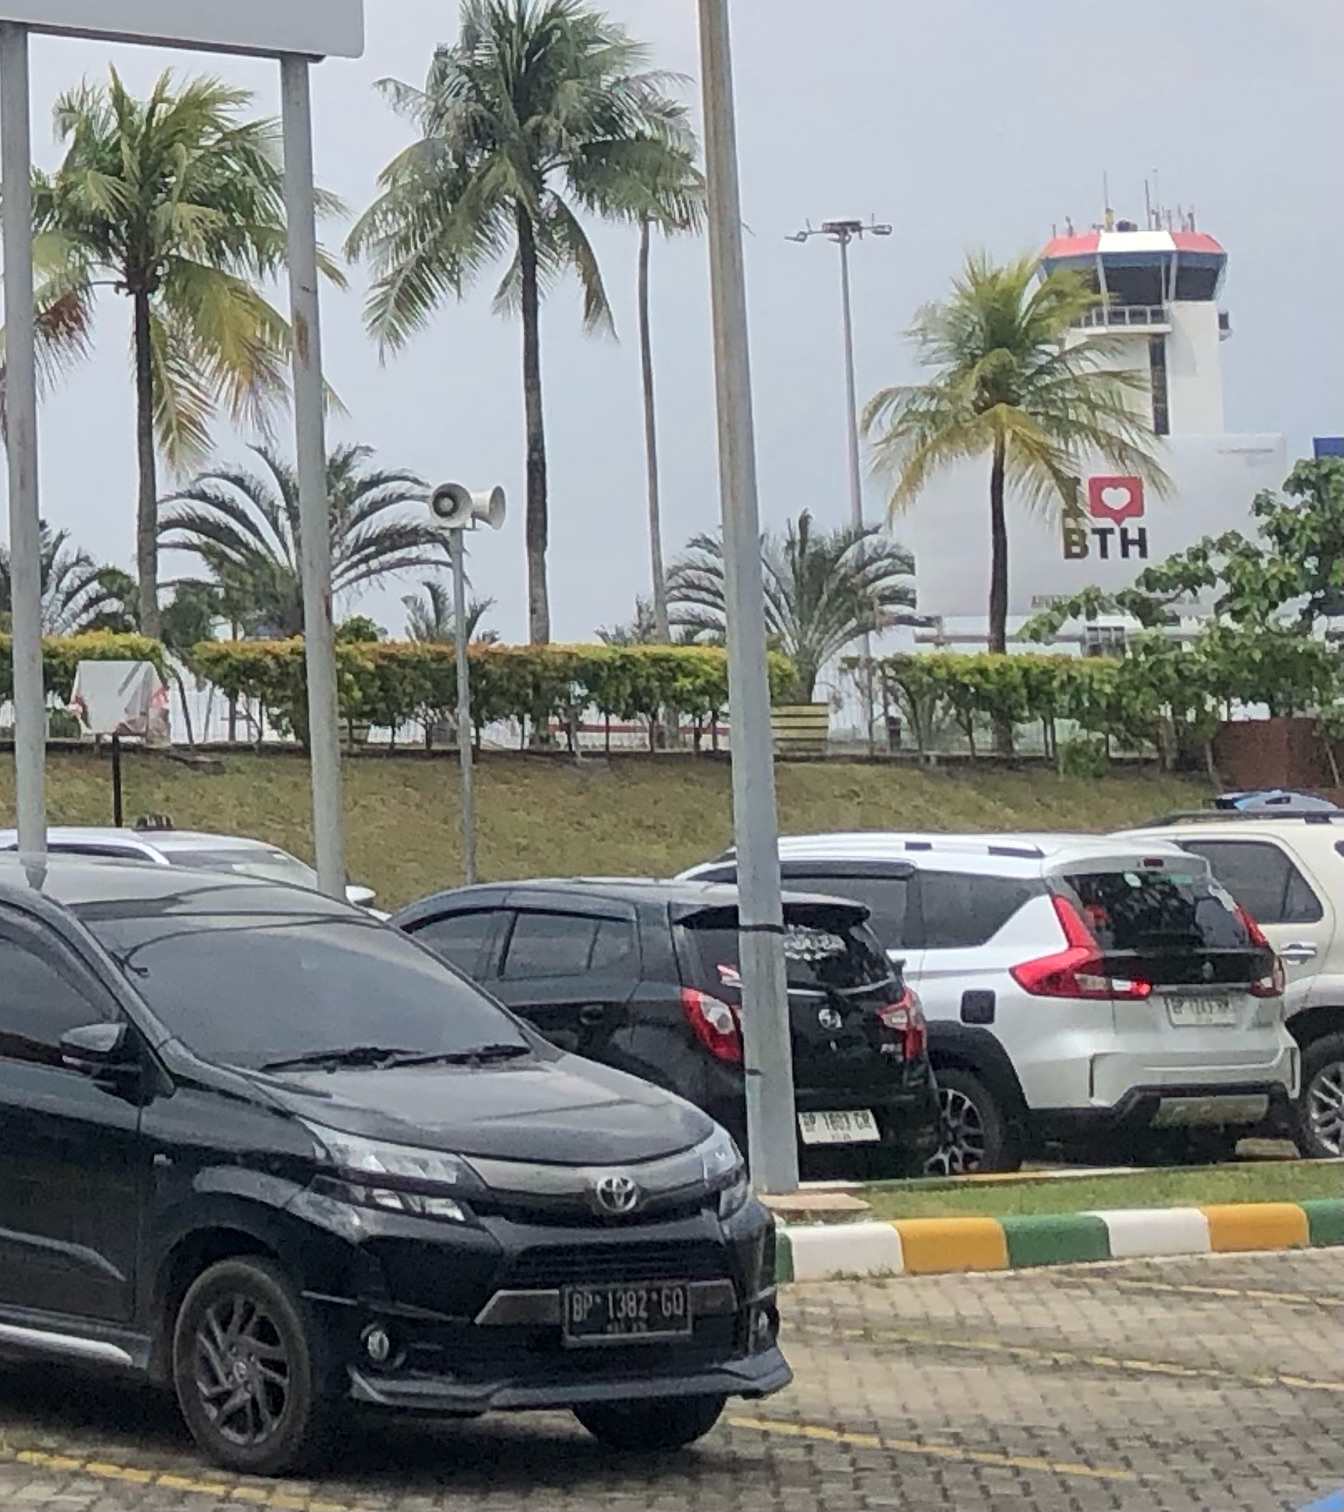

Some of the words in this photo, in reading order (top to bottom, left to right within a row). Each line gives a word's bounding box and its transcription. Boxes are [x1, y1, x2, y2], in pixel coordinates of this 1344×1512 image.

[1063, 526, 1148, 560] BTH
[573, 1291, 593, 1322] BP
[608, 1290, 648, 1319] 1382
